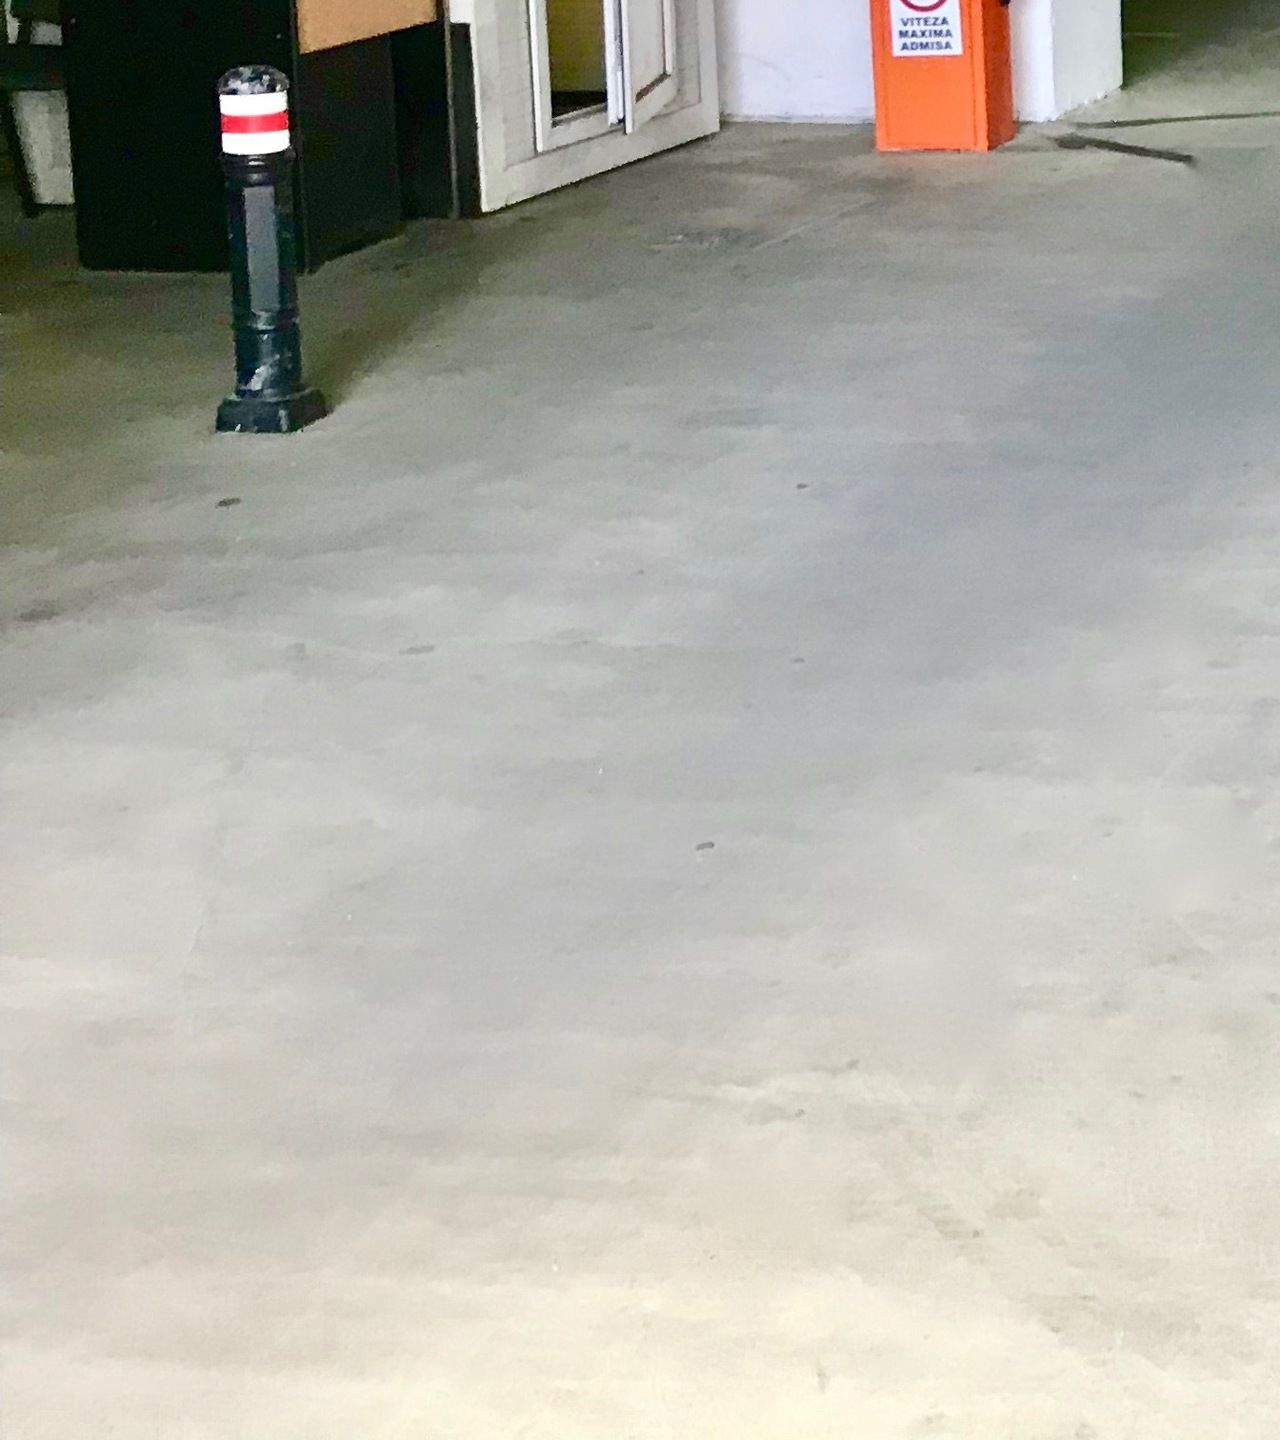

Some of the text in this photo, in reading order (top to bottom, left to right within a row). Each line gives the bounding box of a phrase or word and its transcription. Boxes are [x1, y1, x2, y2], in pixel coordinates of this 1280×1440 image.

[900, 16, 949, 27] VITEZA
[898, 29, 953, 39] MAXIMA
[900, 41, 953, 51] ADMISA
